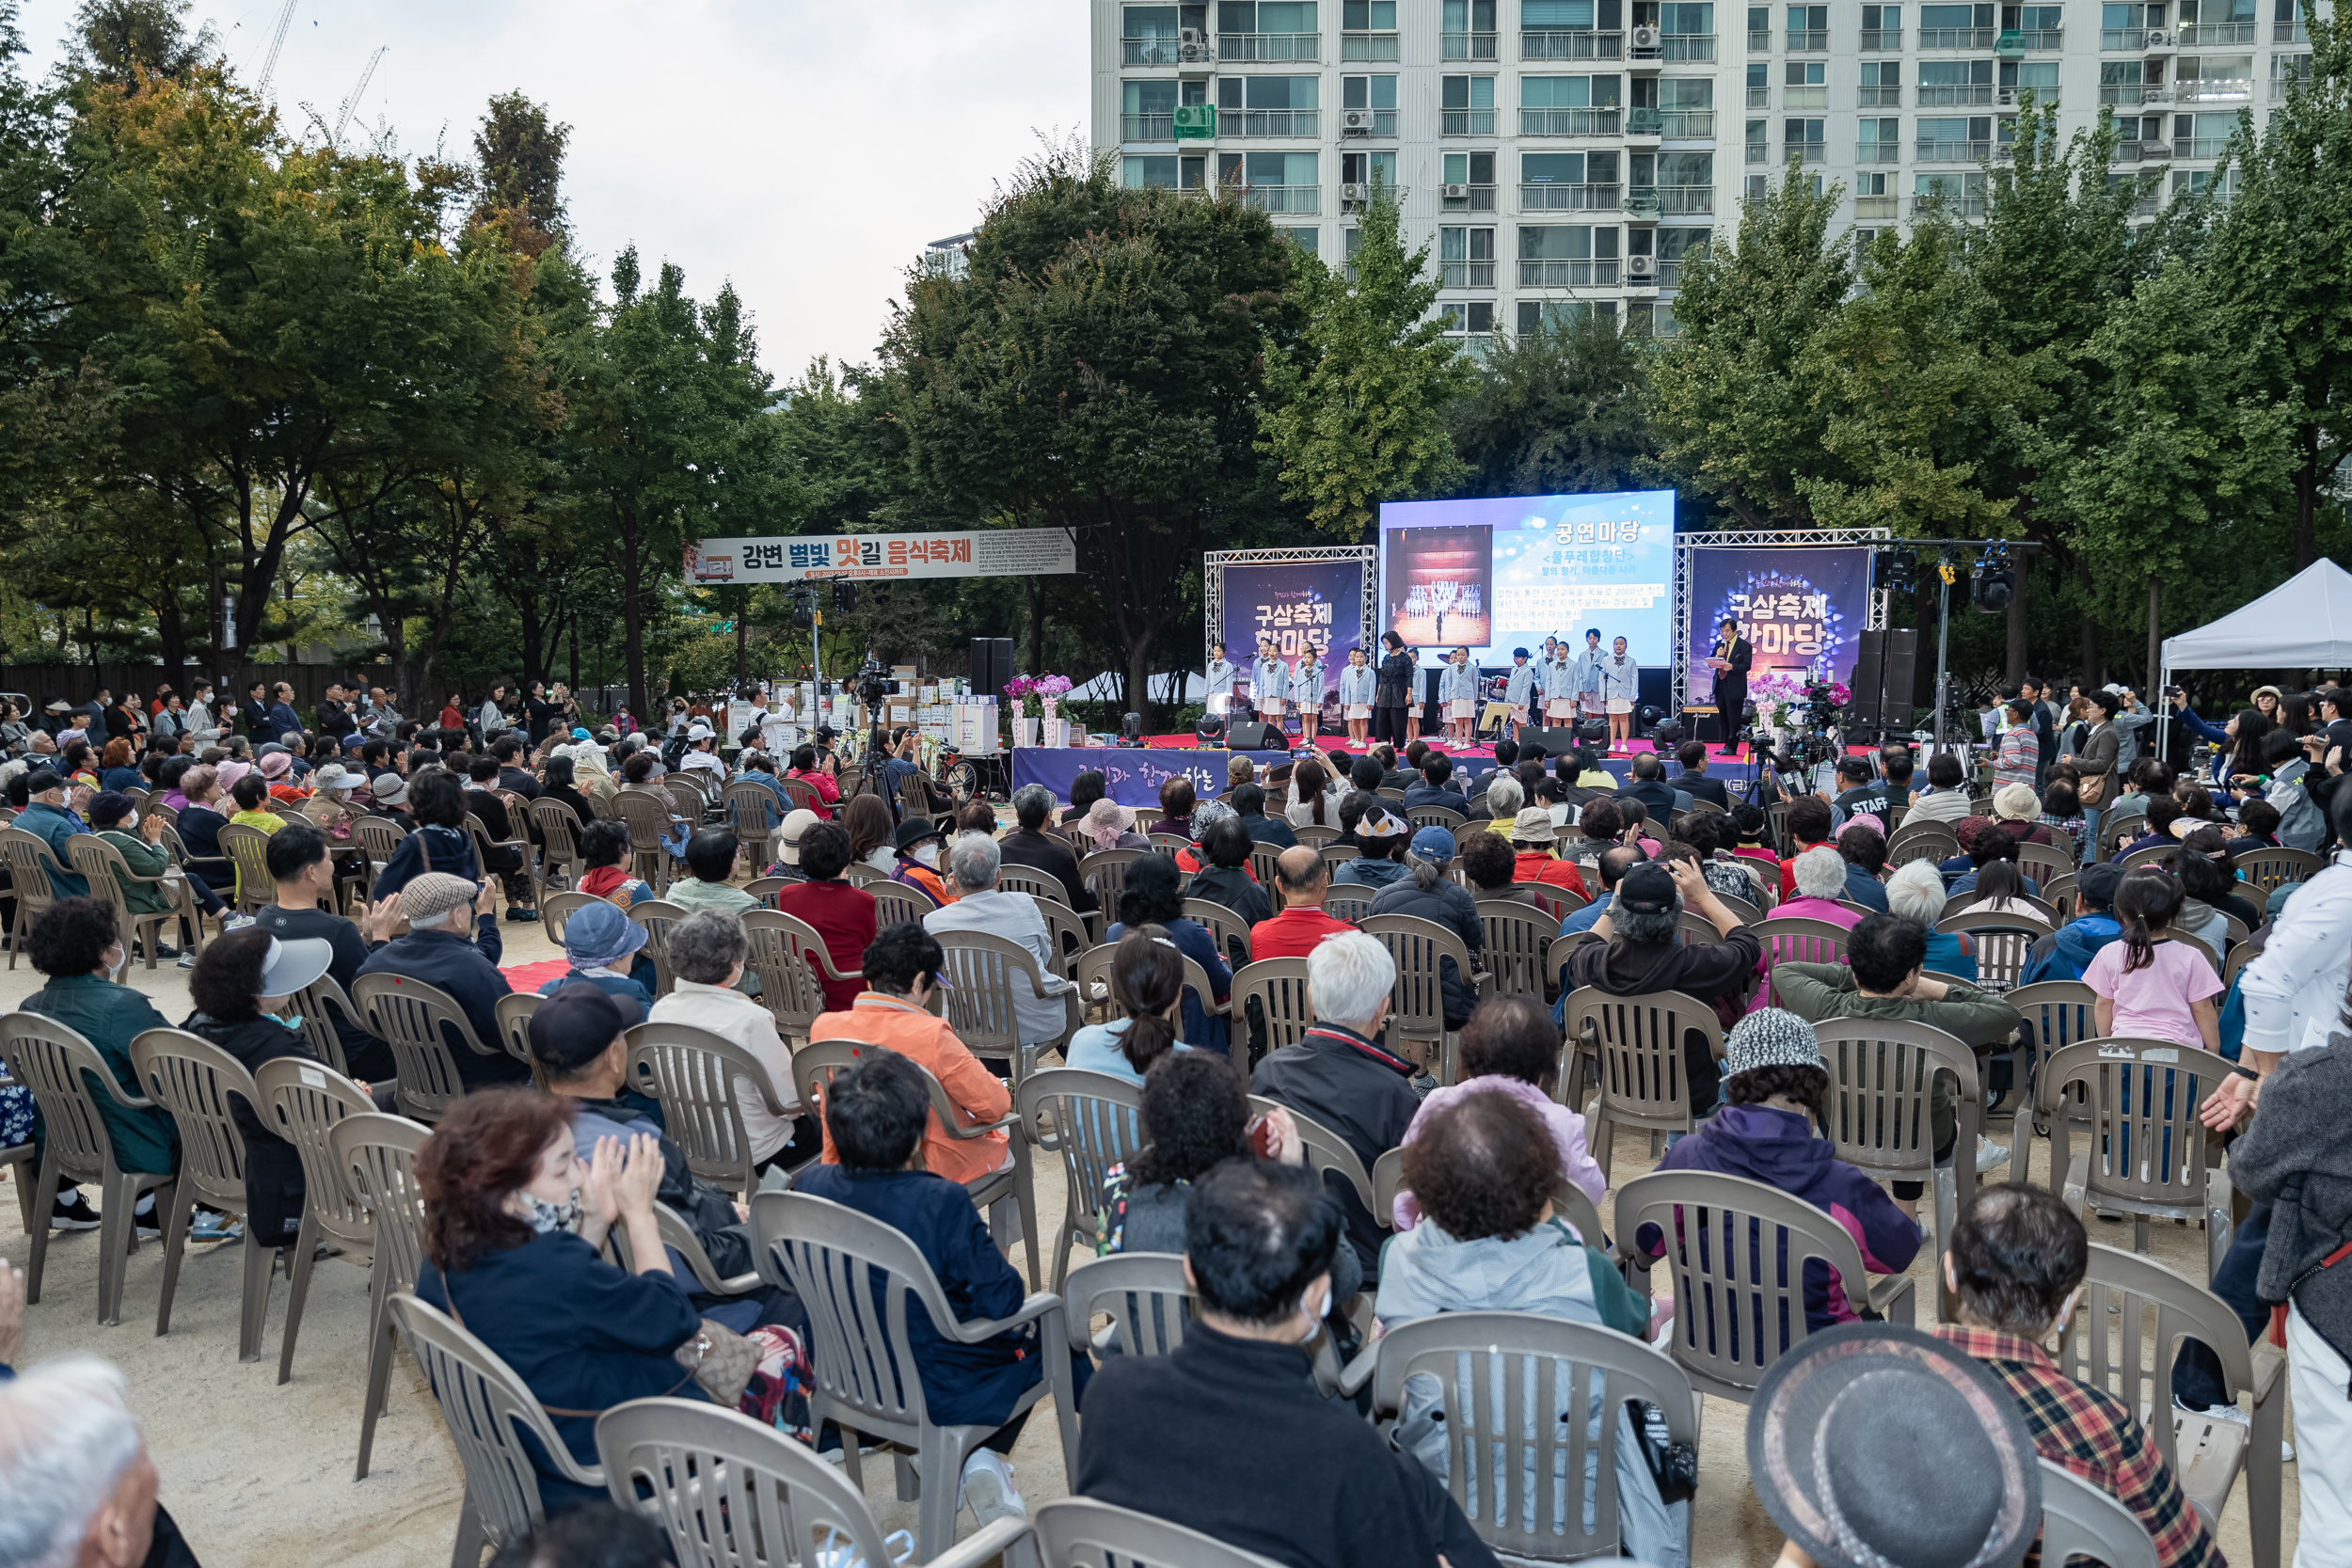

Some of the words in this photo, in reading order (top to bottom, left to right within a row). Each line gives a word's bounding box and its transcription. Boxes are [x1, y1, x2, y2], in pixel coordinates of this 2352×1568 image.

[1555, 520, 1640, 545] 공연마당
[742, 544, 783, 569] 강변
[789, 542, 830, 567] 별빛
[836, 537, 882, 566] 맛길
[887, 538, 971, 565] 음식축제
[1544, 549, 1634, 563] <물푸레합창단>
[1561, 566, 1579, 576] 향기,
[1582, 565, 1615, 575] 아름다운
[1619, 564, 1636, 574] 나라
[1498, 589, 1519, 598] 합창을
[1524, 589, 1539, 598] 통한
[1543, 588, 1583, 597] 인성교육을
[1588, 588, 1612, 596] 목표로
[1616, 587, 1644, 595] 2000년
[1648, 586, 1664, 595] 창단
[1516, 598, 1554, 609] 정기연주회
[1560, 598, 1609, 608] 지역주요행사
[1613, 597, 1637, 607] 경로당
[1642, 597, 1649, 607] 및
[1497, 610, 1545, 619] 요양원등에서
[1549, 610, 1581, 619] 재능봉사
[1497, 621, 1519, 629] 지도자
[1555, 620, 1572, 629] 단장
[1851, 796, 1888, 816] STAFF
